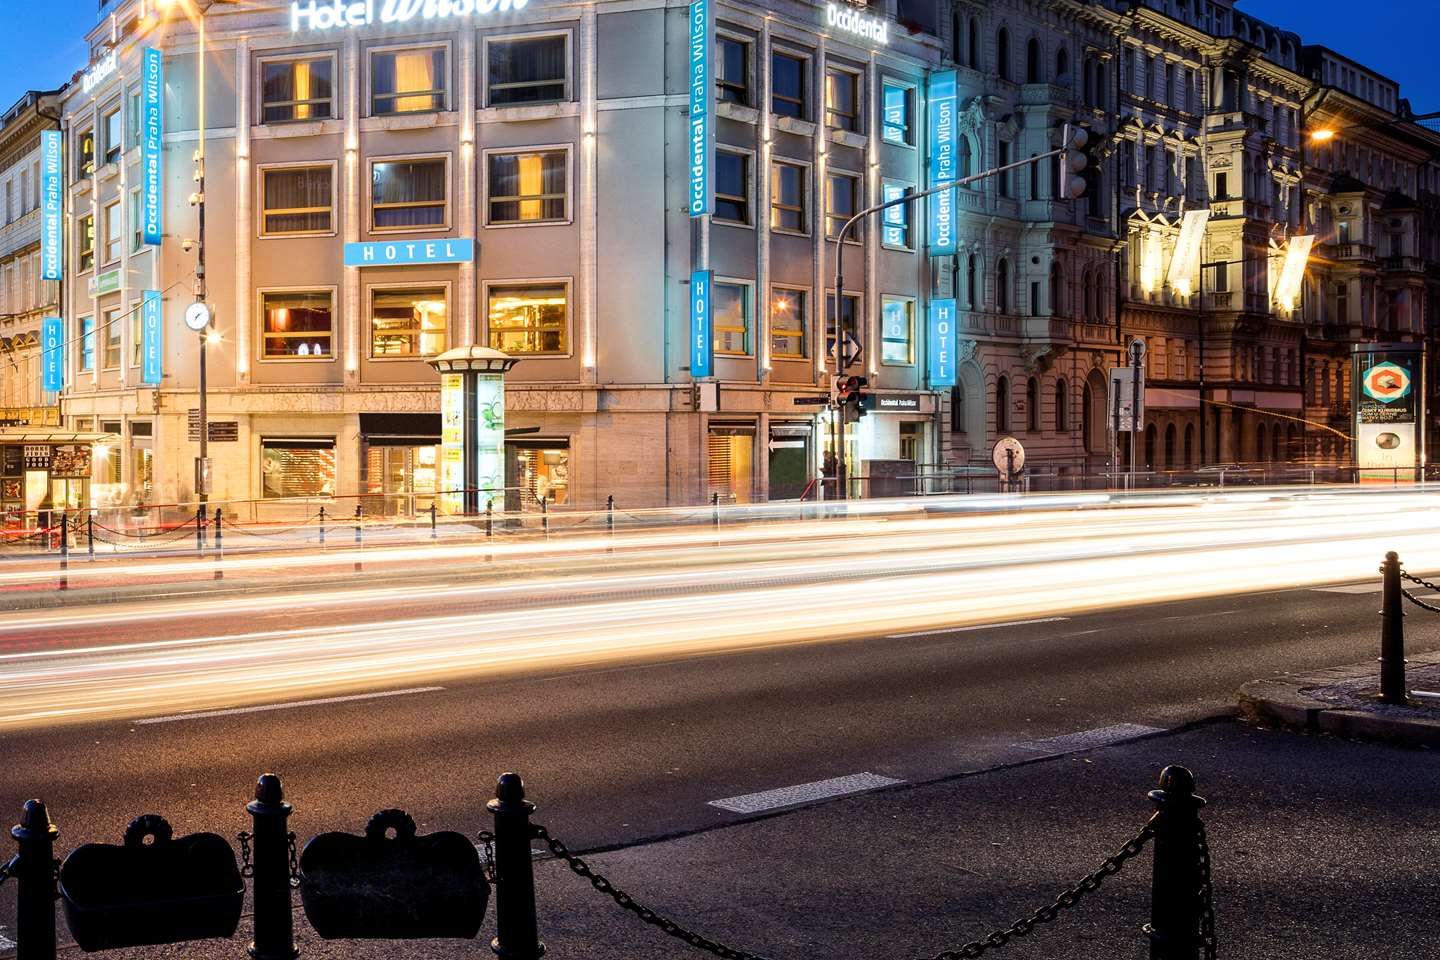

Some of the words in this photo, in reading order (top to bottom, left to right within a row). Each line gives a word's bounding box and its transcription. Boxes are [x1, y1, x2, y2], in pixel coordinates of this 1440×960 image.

[693, 1, 703, 60] Wilson
[827, 3, 888, 45] Occidental
[148, 53, 158, 103] Wilson
[693, 63, 703, 114] Praha
[148, 107, 157, 150] Praha
[937, 101, 950, 142] Wilson
[48, 133, 58, 173] Wilson
[692, 117, 703, 212] Occidental
[938, 144, 950, 180] Praha
[47, 176, 58, 211] Praha
[147, 153, 157, 235] Occidental
[46, 214, 57, 279] Occidental
[363, 243, 455, 261] HOTEL
[148, 299, 156, 375] HOTEL
[696, 281, 704, 367] HOTEL
[938, 307, 948, 378] HOTEL
[48, 325, 56, 385] HOTEL
